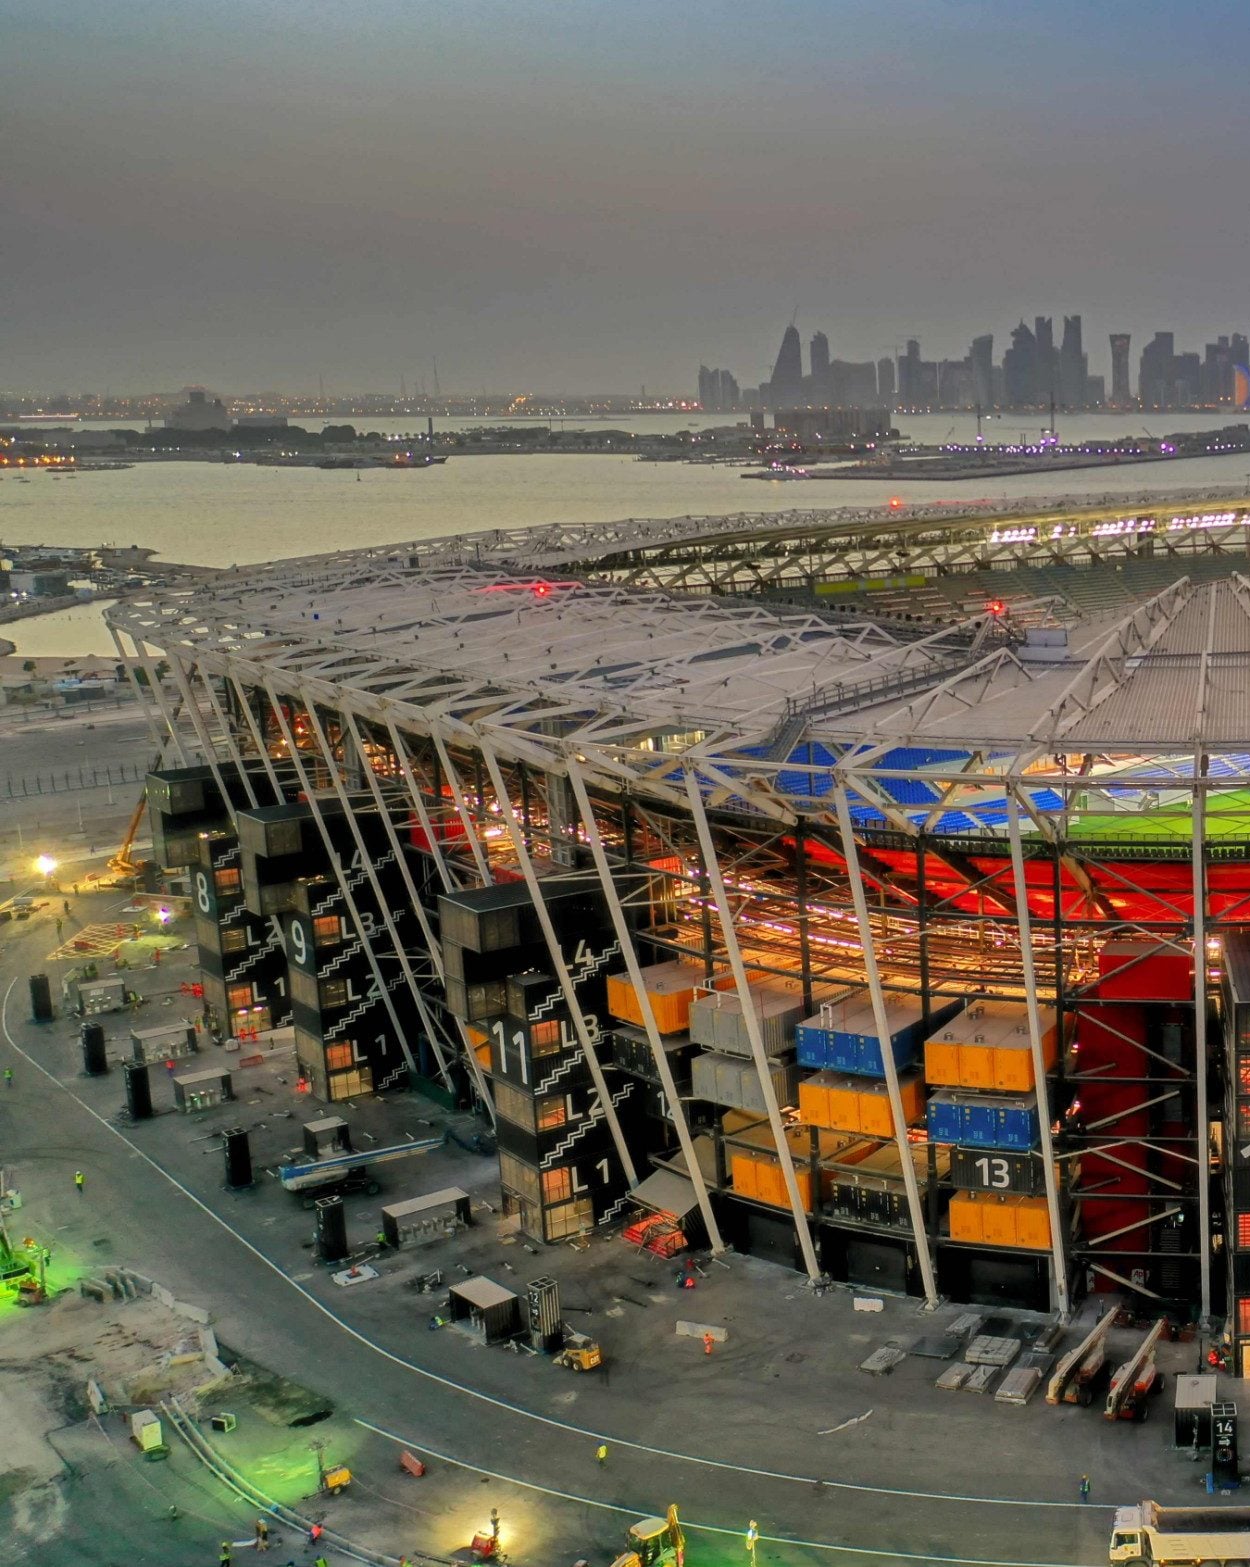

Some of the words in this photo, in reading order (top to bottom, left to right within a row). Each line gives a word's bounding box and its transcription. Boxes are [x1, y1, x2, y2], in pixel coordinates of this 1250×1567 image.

[196, 872, 209, 913] 8
[291, 920, 306, 964] 9
[493, 1021, 528, 1084] 11
[975, 1157, 1010, 1188] 13
[1216, 1422, 1233, 1433] 14
